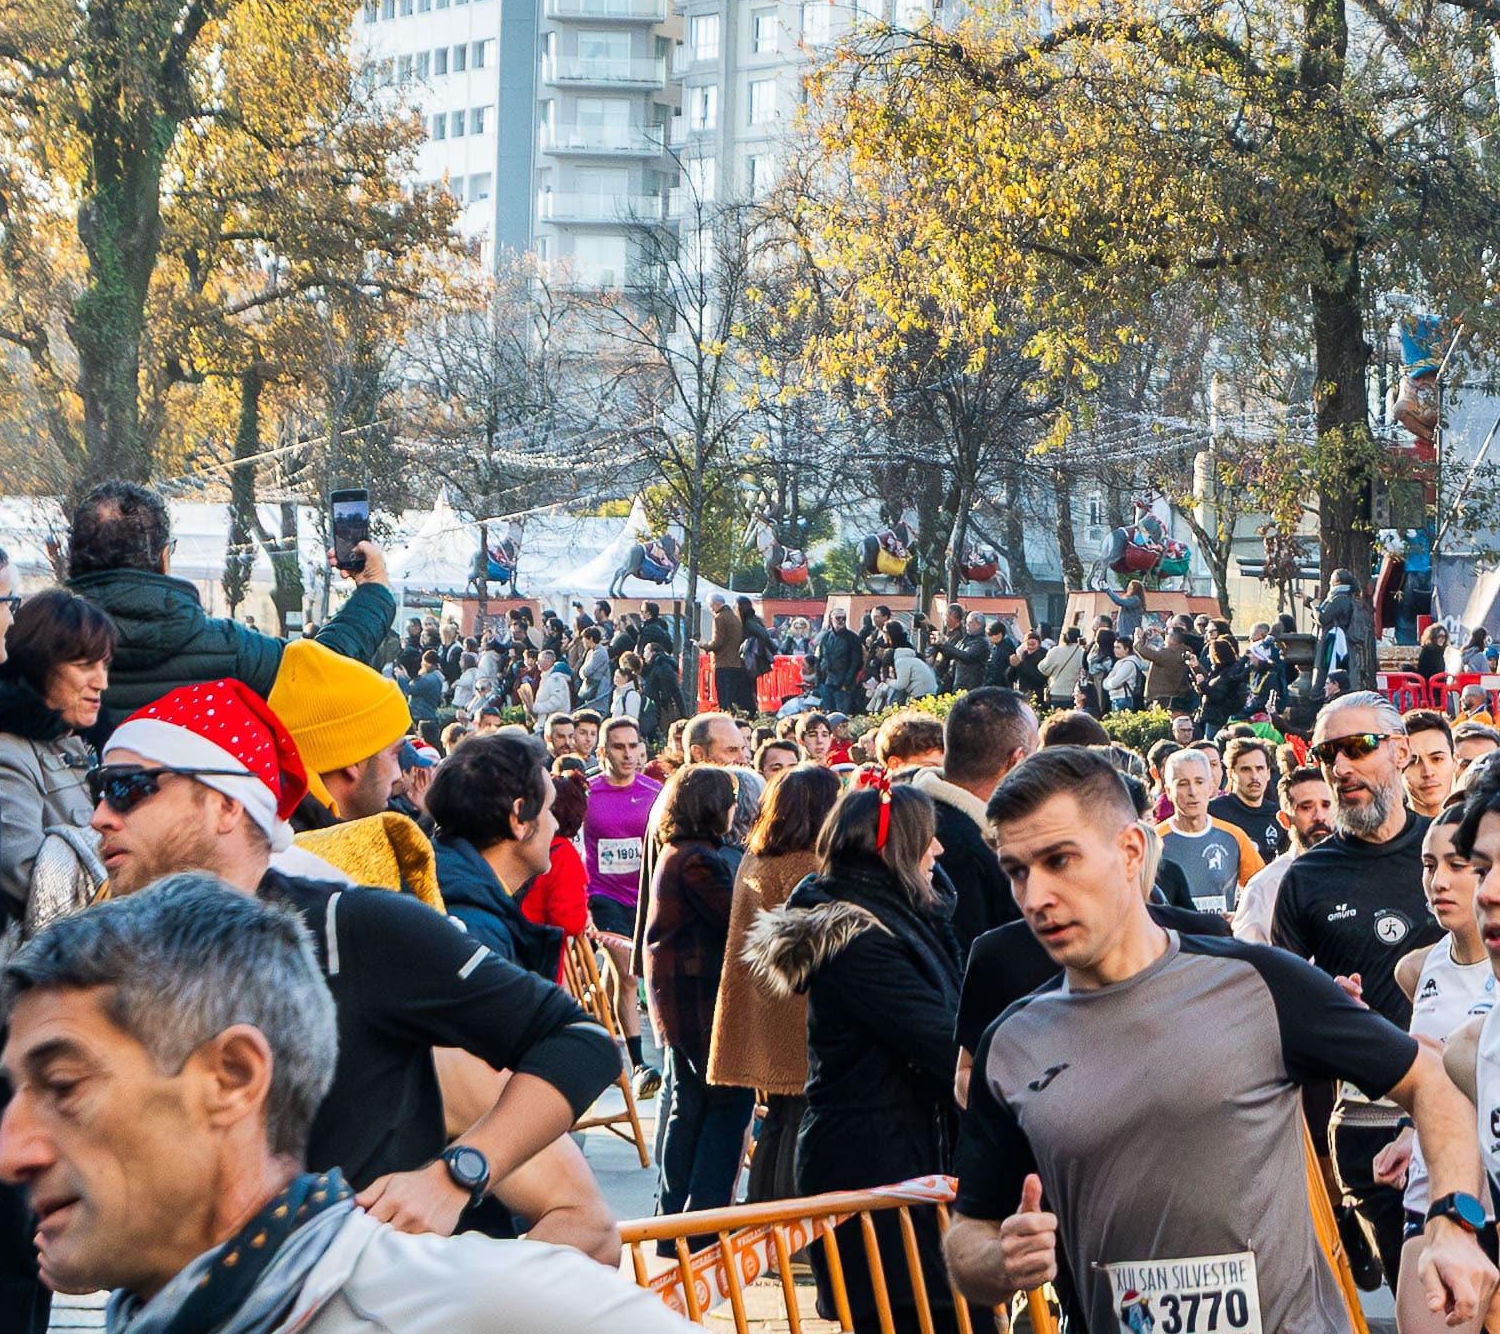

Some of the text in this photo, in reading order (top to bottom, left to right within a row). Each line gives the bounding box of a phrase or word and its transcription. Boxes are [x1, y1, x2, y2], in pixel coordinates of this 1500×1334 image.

[1139, 1267, 1168, 1291] SAN
[1171, 1259, 1248, 1289] SILVESTRE
[1160, 1288, 1249, 1334] 3770
